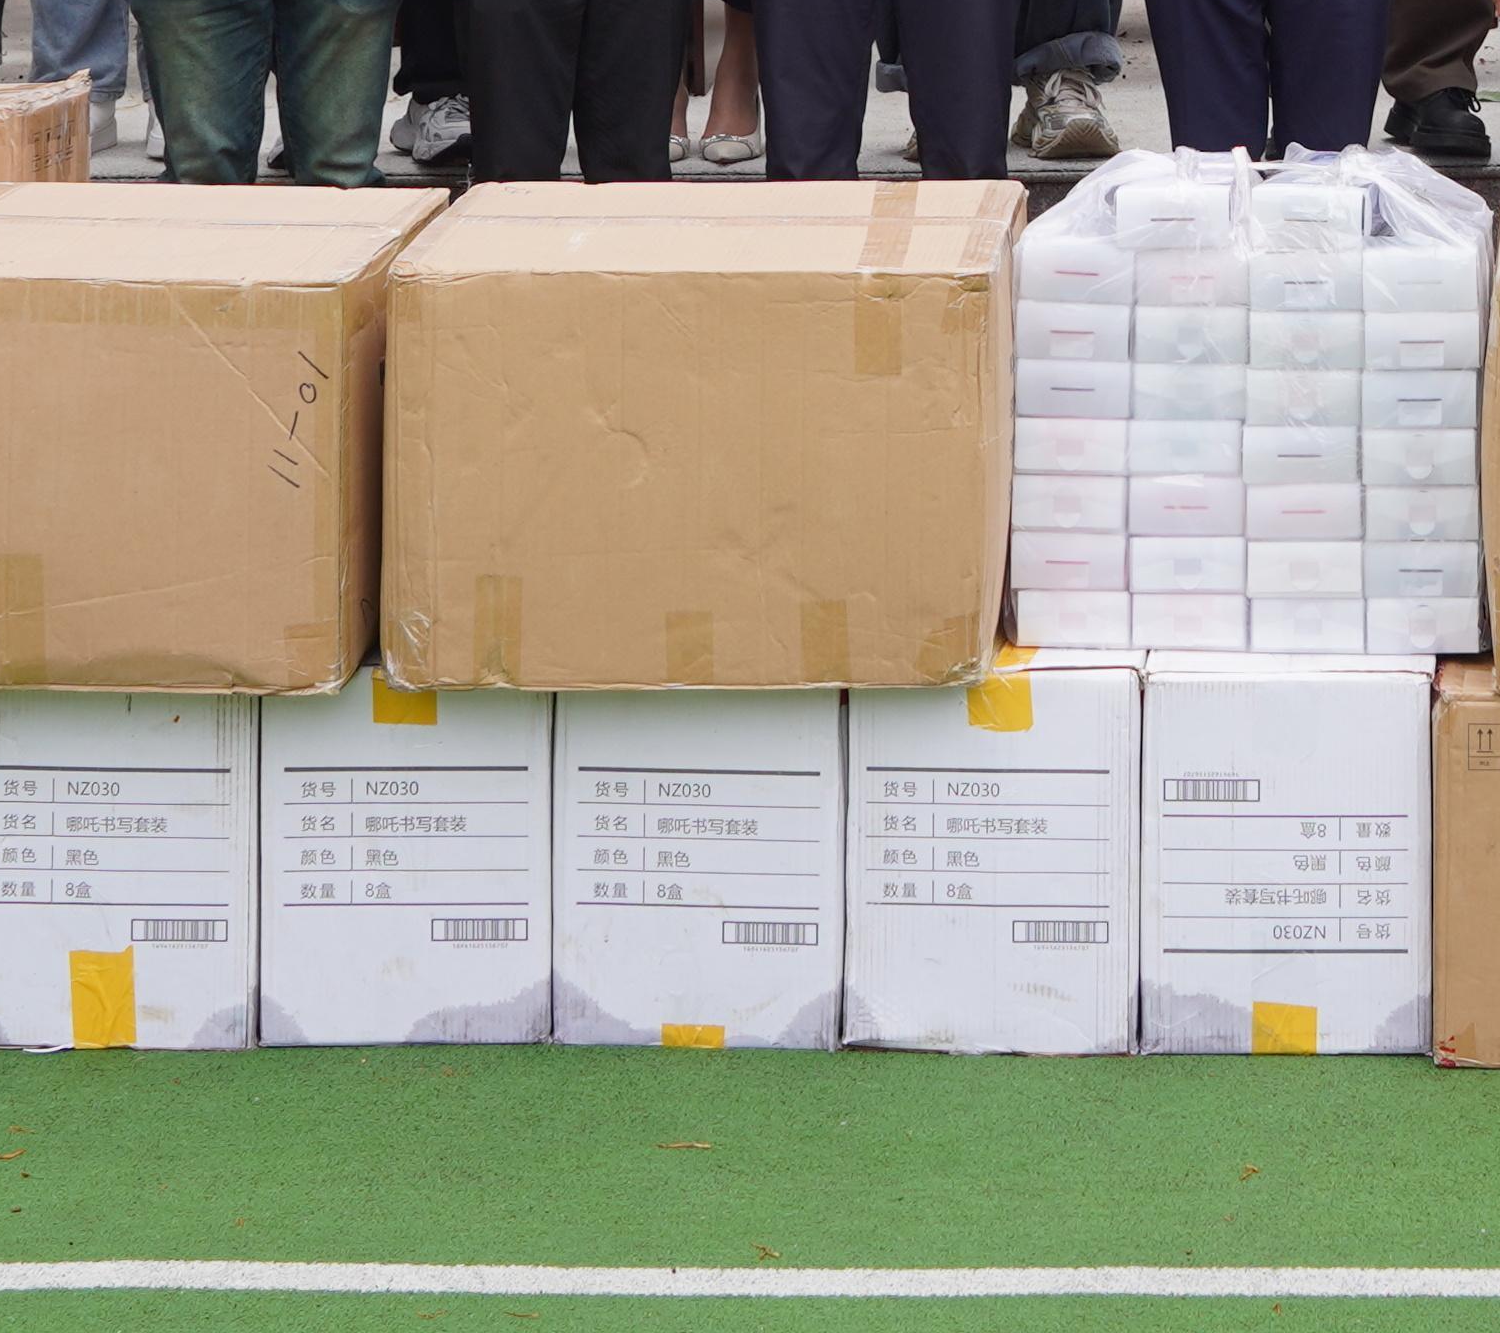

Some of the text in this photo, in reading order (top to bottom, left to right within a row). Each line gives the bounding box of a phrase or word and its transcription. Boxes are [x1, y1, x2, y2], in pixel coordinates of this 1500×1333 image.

[4, 779, 119, 796] 货号 NZ030
[301, 781, 419, 798] 货号 NZ030
[595, 781, 711, 797] 货号 NZ030
[884, 781, 1000, 797] 货号 NZ030
[2, 814, 167, 835] 货名 哪吒书写套装
[302, 815, 466, 835] 货名 哪吒书写套装
[594, 815, 758, 836] 货名 哪吒书写套装
[884, 814, 1047, 836] 货名 哪吒书写套装
[2, 847, 99, 868] 颜色 黑色
[301, 848, 399, 868] 颜色 黑色
[594, 849, 690, 870] 颜色 黑色
[883, 849, 980, 869] 颜色 黑色
[0, 882, 92, 901] 数量 8盒
[301, 882, 391, 899] 数量 8盒
[592, 882, 683, 902] 数量 8盒
[882, 882, 972, 901] 数量 8盒
